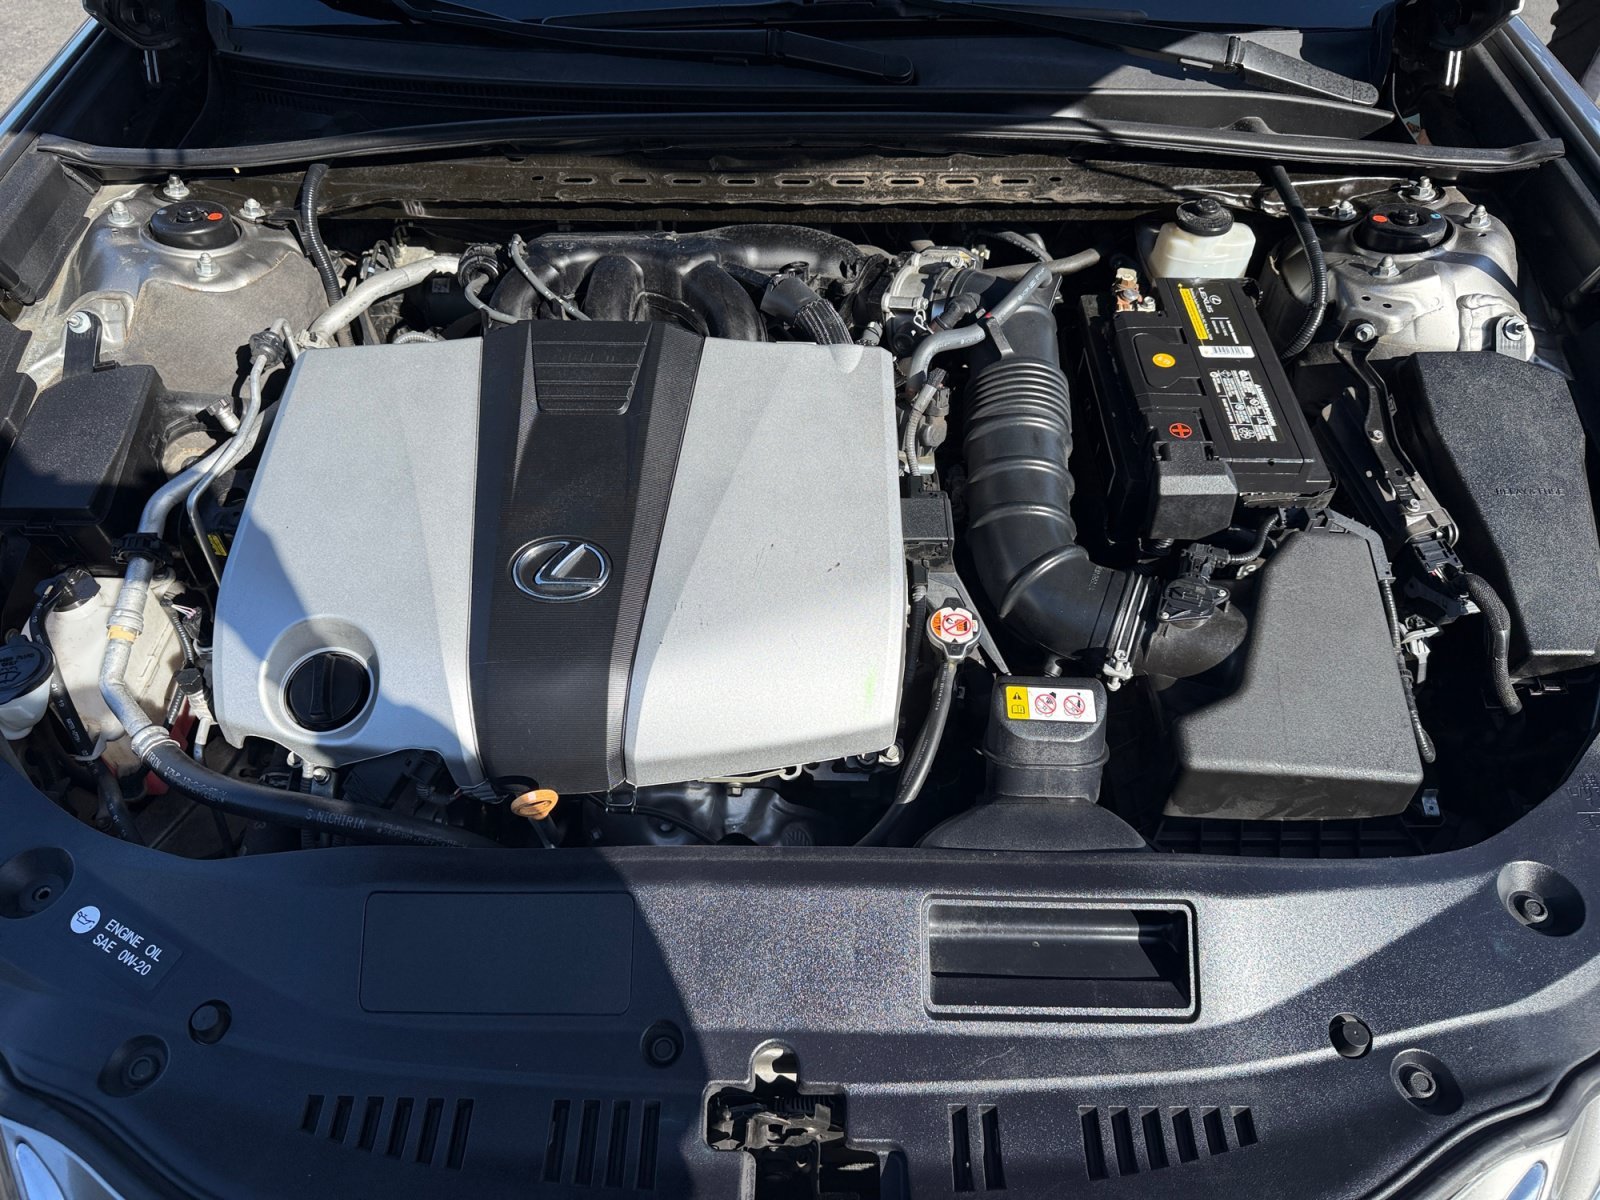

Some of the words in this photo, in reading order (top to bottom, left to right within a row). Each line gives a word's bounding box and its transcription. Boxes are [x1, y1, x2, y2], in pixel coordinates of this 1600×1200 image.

[1198, 287, 1214, 313] LEXUS
[316, 811, 367, 830] NICHIRIN
[92, 933, 117, 954] SAE
[117, 949, 152, 975] 0W-20
[105, 919, 144, 948] ENGINE
[144, 944, 164, 962] OIL
